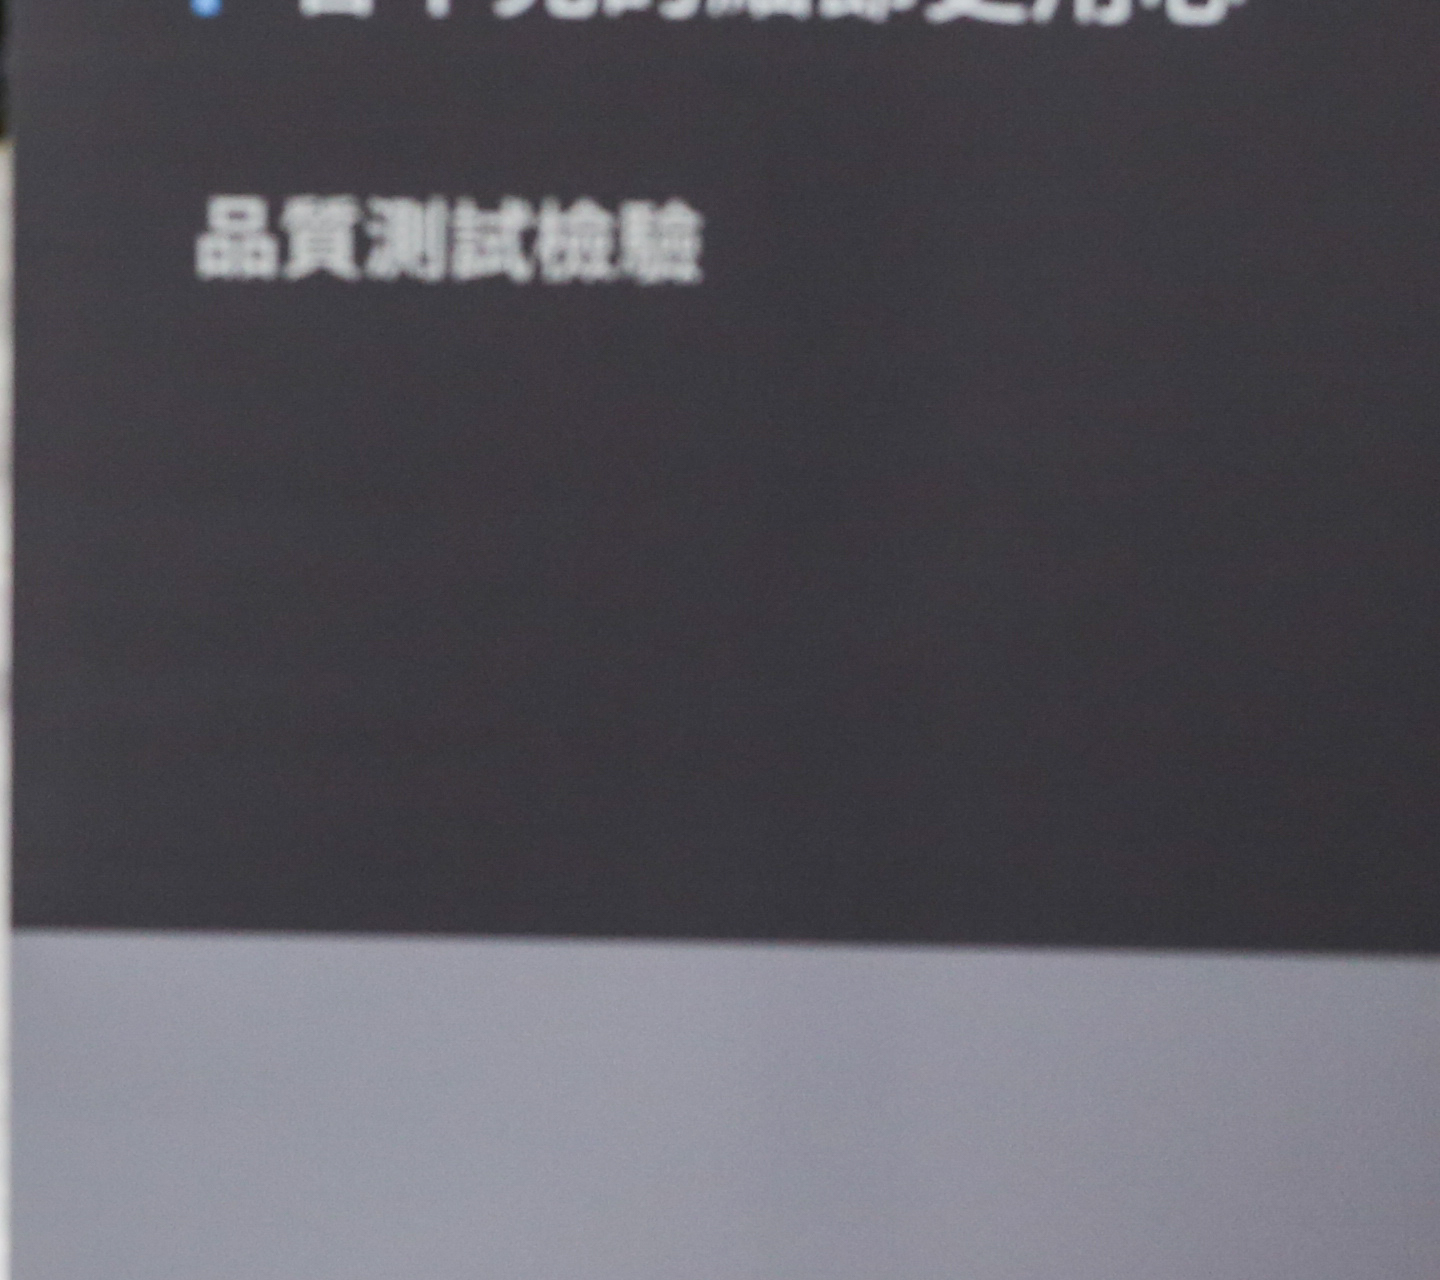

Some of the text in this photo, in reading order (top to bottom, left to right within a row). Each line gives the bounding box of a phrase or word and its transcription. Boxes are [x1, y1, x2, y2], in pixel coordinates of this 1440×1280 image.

[195, 194, 704, 285] 品質測試檢驗
